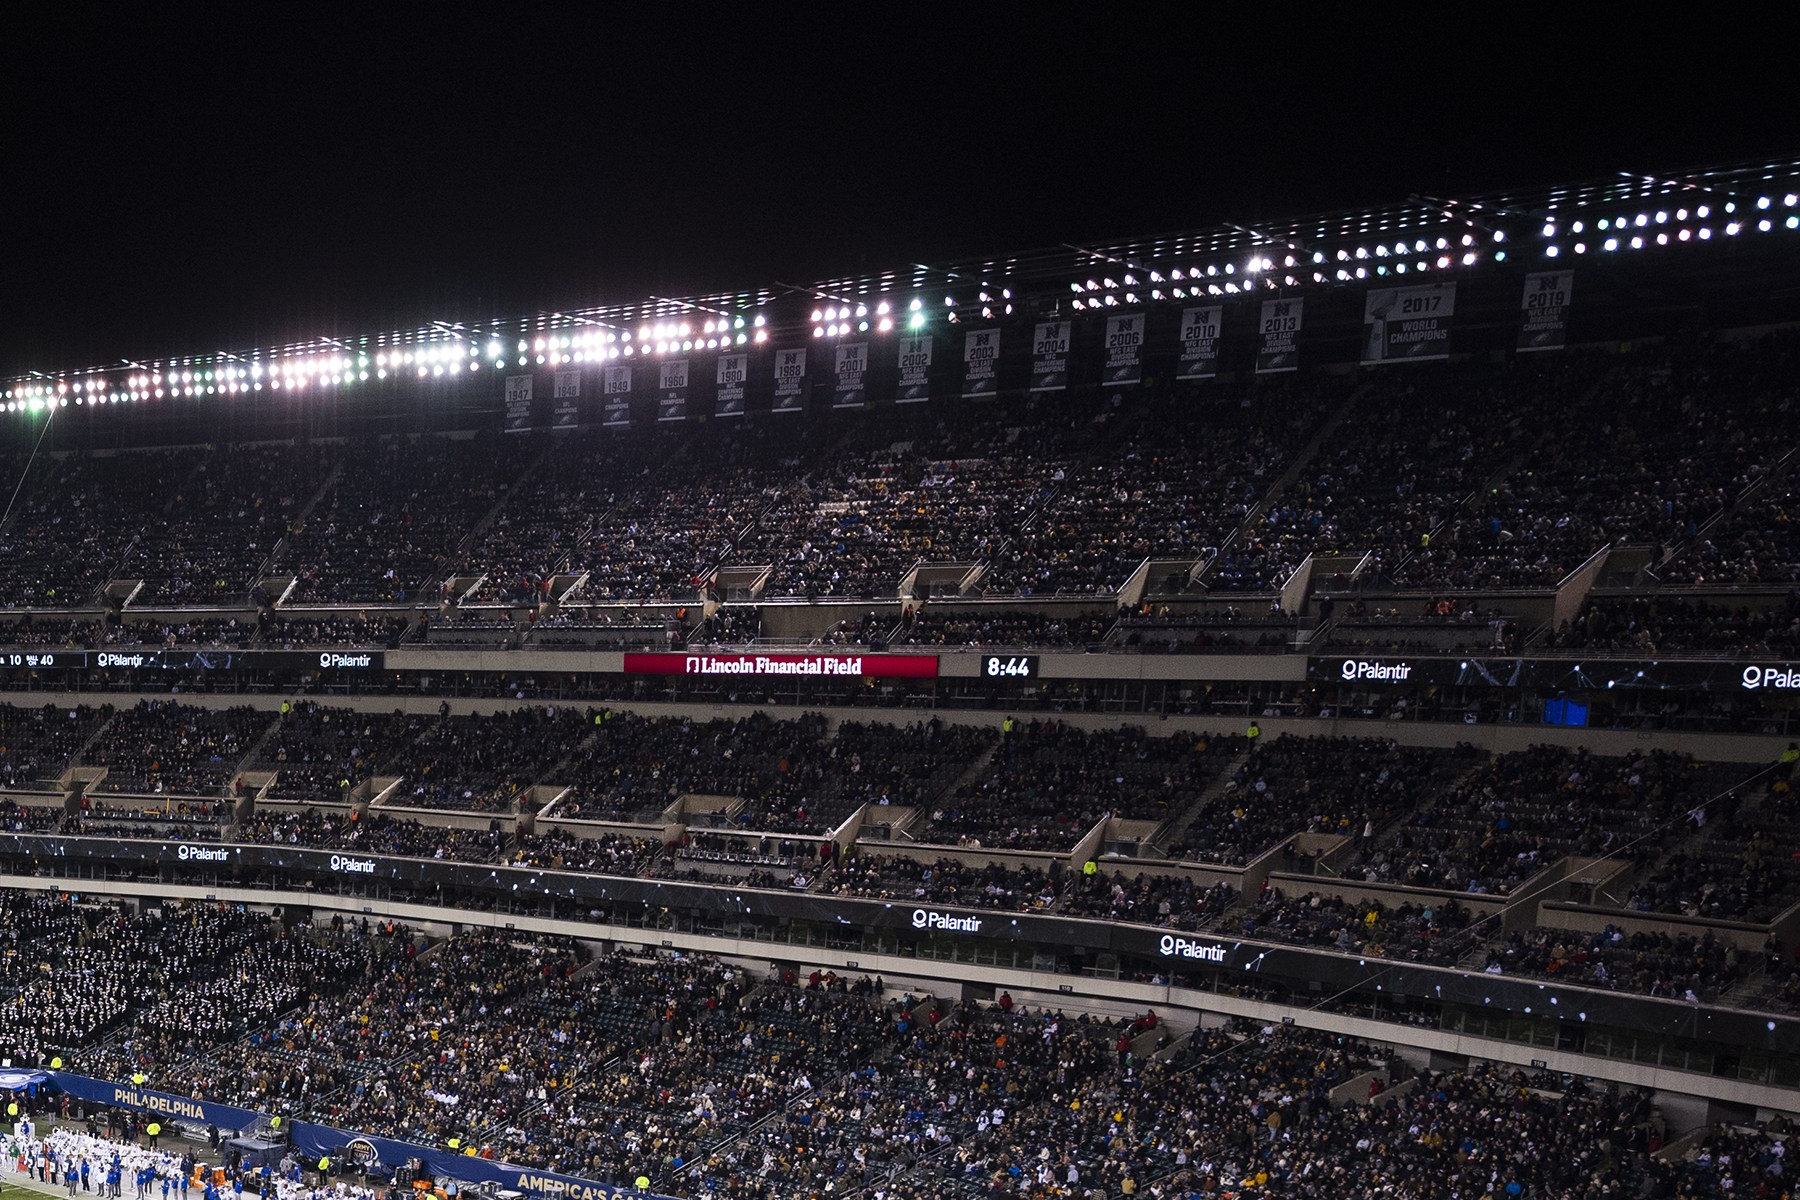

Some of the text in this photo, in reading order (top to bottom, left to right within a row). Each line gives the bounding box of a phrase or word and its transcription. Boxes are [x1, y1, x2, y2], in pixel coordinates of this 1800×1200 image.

[1402, 296, 1441, 314] 2017
[1528, 292, 1564, 307] 2019
[1266, 318, 1296, 332] 2013
[1402, 320, 1437, 332] WORLD
[1110, 332, 1138, 346] 2006
[1186, 326, 1214, 339] 2010
[1390, 330, 1447, 344] CHAMPIONS
[970, 348, 994, 359] 2003
[1038, 340, 1065, 354] 2004
[840, 360, 862, 372] 2001
[902, 354, 928, 366] 2002
[722, 370, 742, 382] 1980
[780, 366, 800, 376] 1988
[608, 381, 628, 392] 1949
[664, 376, 684, 387] 1960
[509, 390, 528, 400] 1947
[558, 386, 576, 396] 1948
[10, 654, 21, 666] 10
[40, 654, 54, 666] 40
[108, 653, 143, 667] Palantir
[332, 654, 370, 667] Palantir
[701, 658, 862, 676] Lincoln Financial Field
[987, 658, 1030, 676] 8:44
[1358, 662, 1412, 680] Palantir
[190, 846, 228, 861] Palantir
[340, 858, 376, 873] Palantir
[928, 912, 981, 932] Palantir
[1174, 940, 1226, 962] Palantir
[114, 1088, 204, 1120] PHILADELPHIA
[352, 1142, 370, 1151] ARMY
